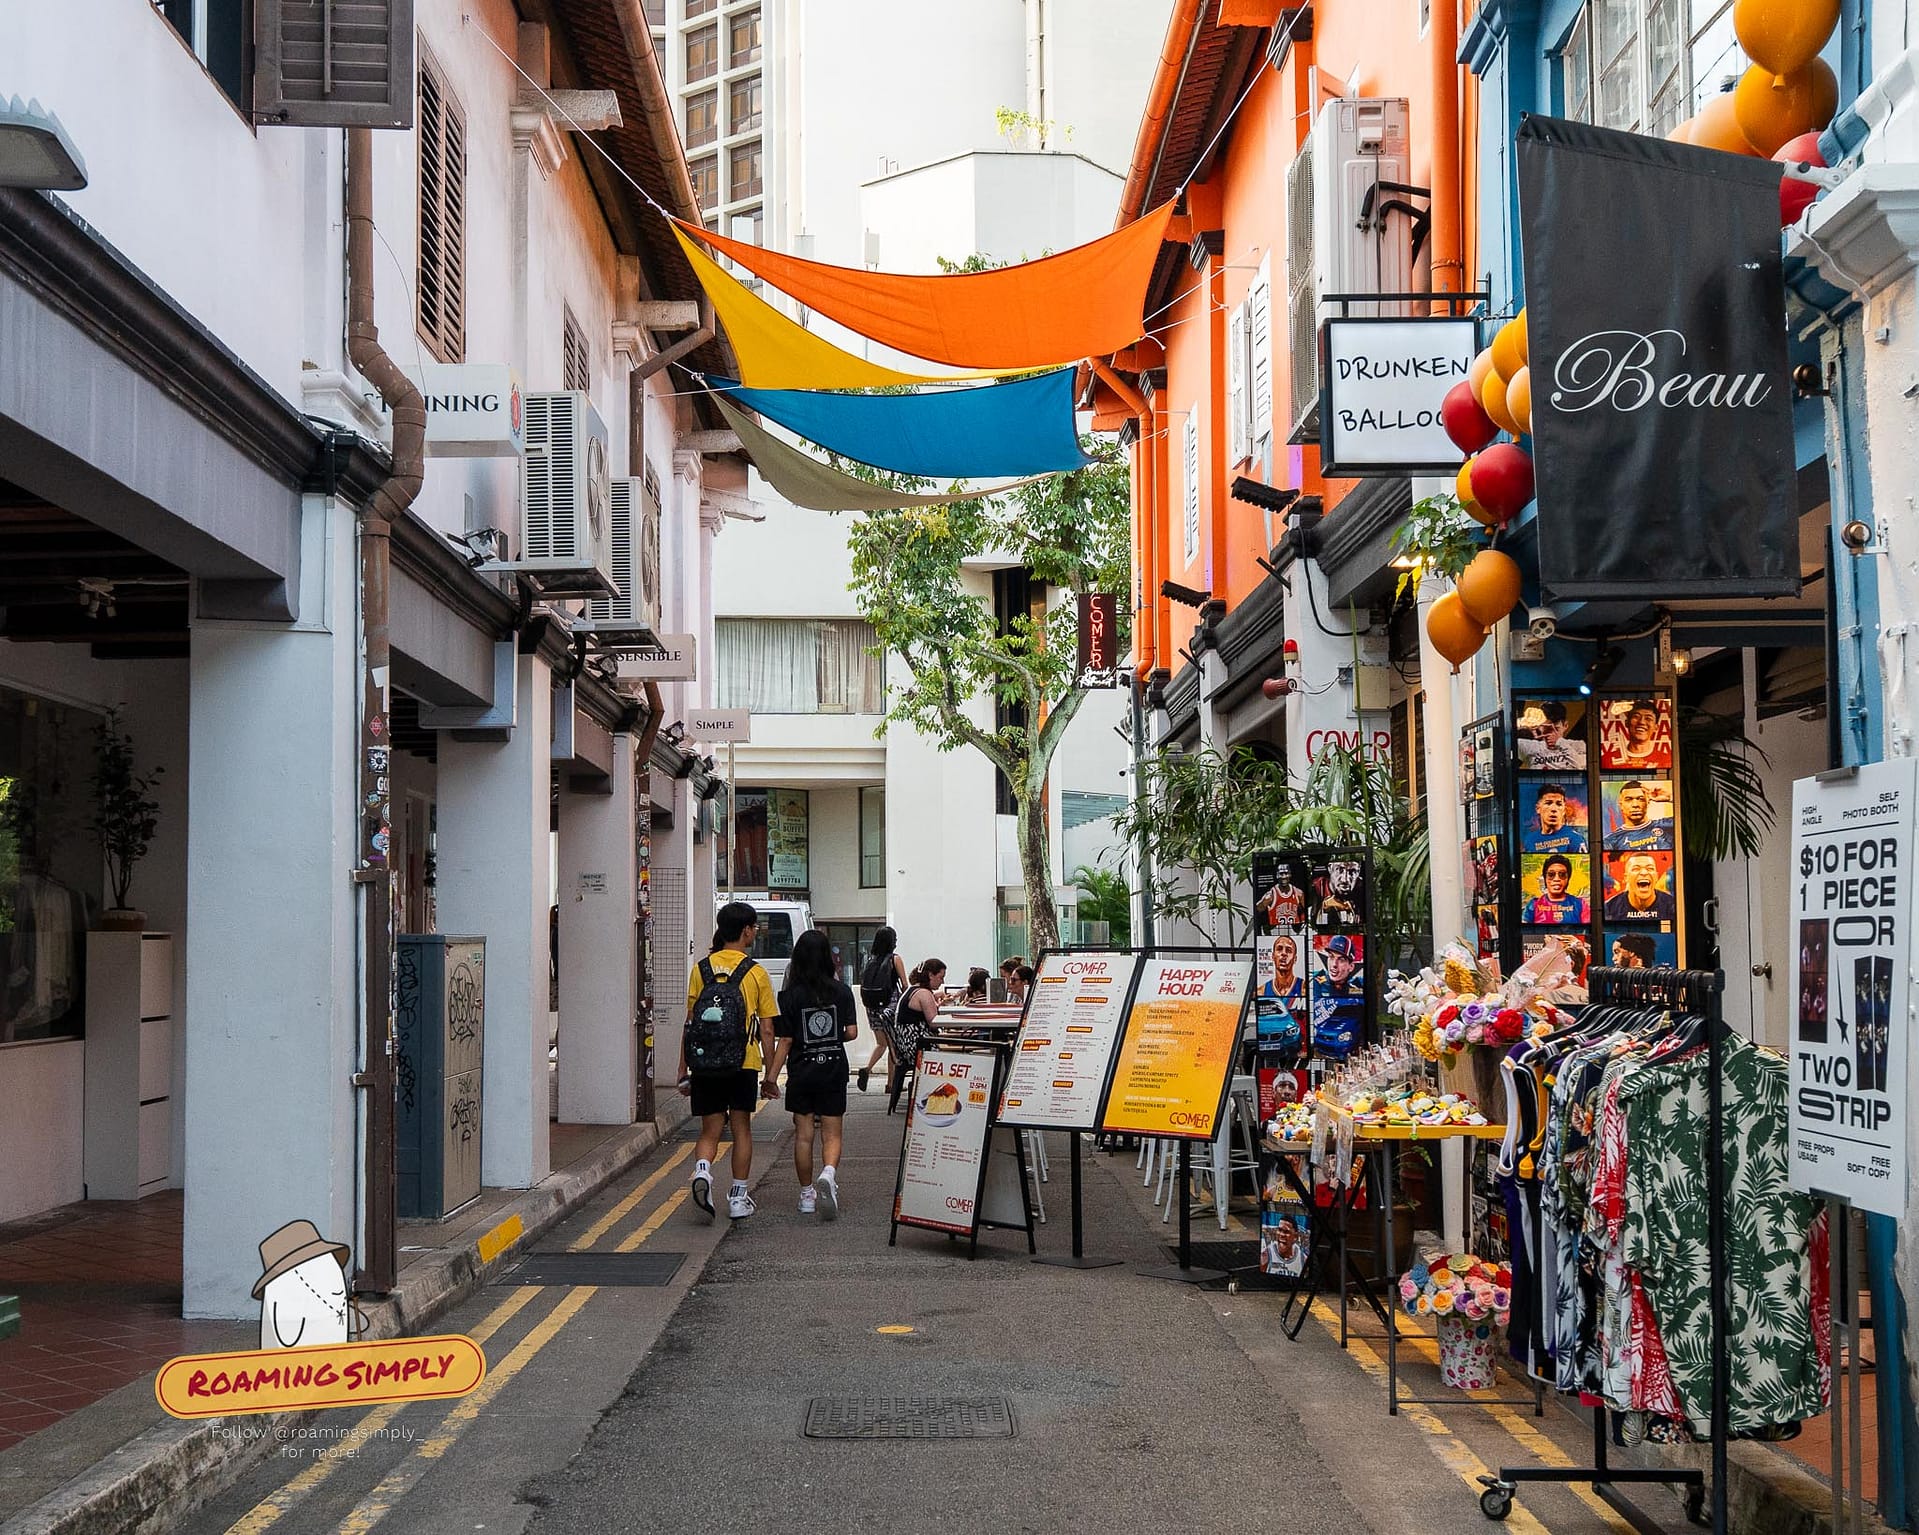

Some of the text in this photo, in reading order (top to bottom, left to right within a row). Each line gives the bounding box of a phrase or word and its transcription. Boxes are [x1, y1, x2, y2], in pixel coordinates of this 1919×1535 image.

[1336, 356, 1468, 380] DRUNKEN
[1551, 329, 1772, 412] Beau
[1090, 596, 1104, 669] COMER
[617, 650, 682, 662] SENSIBLE
[1306, 730, 1391, 766] COMR
[1879, 791, 1899, 803] SELF
[1802, 805, 1817, 815] HIGH
[1843, 803, 1899, 820] PHOTO BOOTH
[1802, 815, 1822, 826] ANGLE
[1800, 837, 1897, 879] $10 FOR
[1800, 875, 1896, 911] 1 PIECE
[1833, 915, 1895, 946] OR
[1159, 968, 1213, 982] HAPPY
[1158, 983, 1204, 996] HOUR
[923, 1061, 971, 1079] TEA SET
[1799, 1052, 1851, 1087] TWO
[1798, 1087, 1891, 1131] STRIP
[1169, 1112, 1210, 1128] COMER
[1798, 1139, 1835, 1156] FREE PROPS
[1798, 1152, 1818, 1163] USAGE
[1871, 1156, 1891, 1168] FREE
[1847, 1162, 1891, 1180] SOFT COPY
[945, 1197, 973, 1213] COMER
